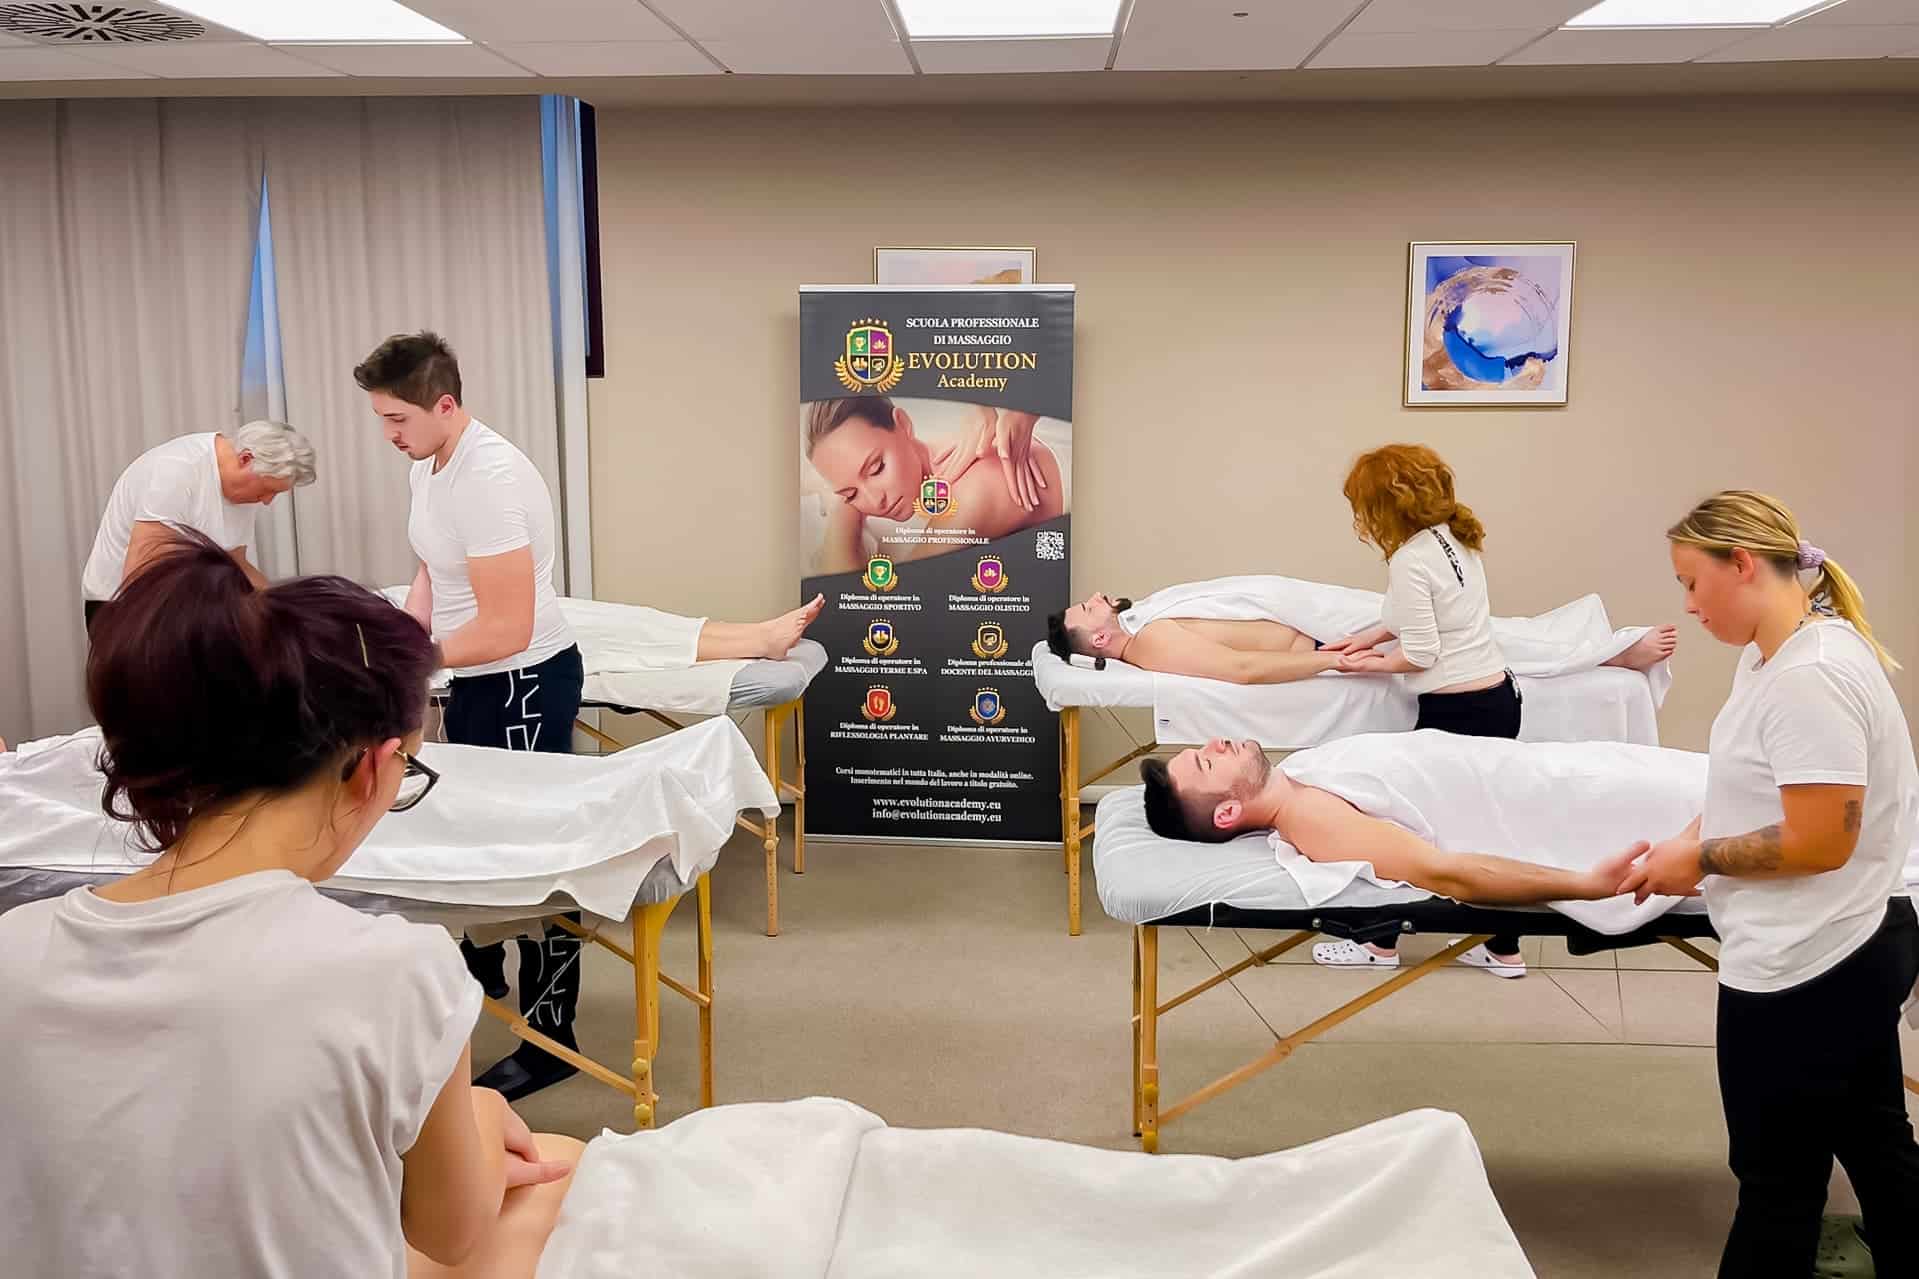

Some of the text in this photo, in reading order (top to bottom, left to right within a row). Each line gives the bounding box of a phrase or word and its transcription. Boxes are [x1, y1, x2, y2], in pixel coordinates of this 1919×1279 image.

[906, 318, 1040, 328] SCUOLA PROFESSIONALE
[934, 335, 1012, 345] DI MASSAGGIO
[908, 352, 1037, 370] EVOLUTION
[937, 374, 1008, 391] Academy
[839, 602, 882, 610] MASSAGGIO
[994, 604, 1030, 612] OLISTICO
[873, 796, 1001, 811] www.evolutionacademy.eu
[872, 808, 1001, 824] info@evolutionacademy.eu
